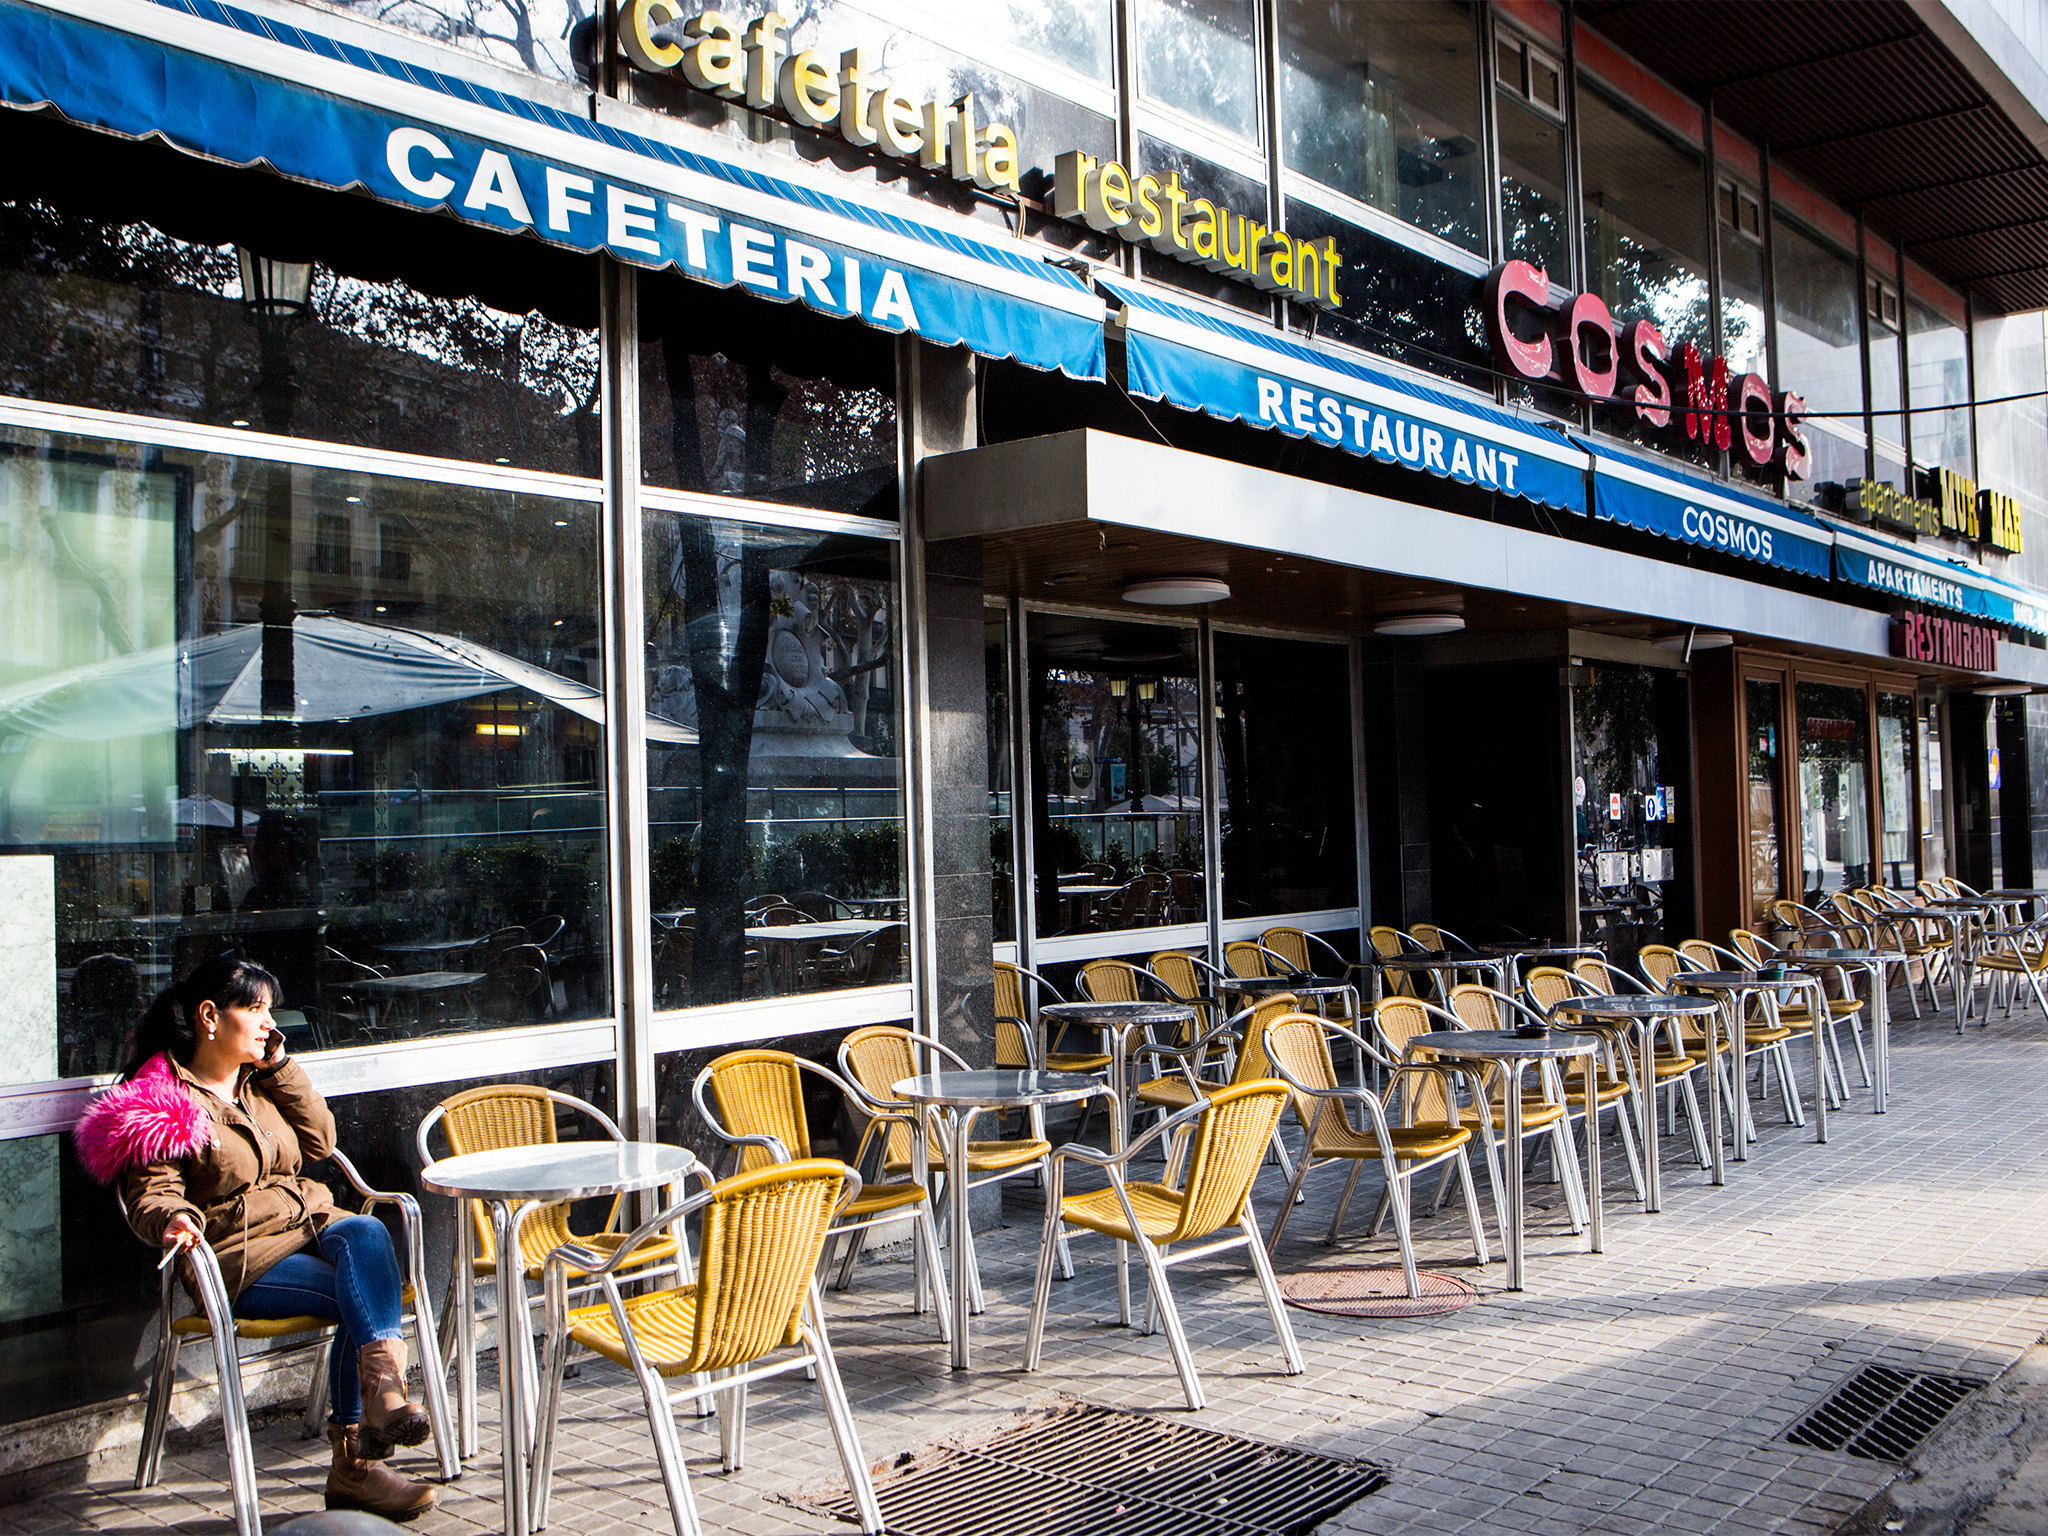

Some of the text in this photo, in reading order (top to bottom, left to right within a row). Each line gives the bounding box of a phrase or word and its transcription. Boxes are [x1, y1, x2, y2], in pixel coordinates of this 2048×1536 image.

[386, 126, 921, 330] CAFETERIA
[1056, 150, 1342, 308] restaurant
[1486, 259, 1812, 481] COSMOS
[1257, 376, 1520, 489] RESTAURANT
[1682, 505, 1773, 560] COSMOS
[1853, 466, 2023, 554] apartaments MUR MAR
[1868, 559, 1964, 611] APARTAMENTS
[1903, 610, 1999, 672] RESTAURANT
